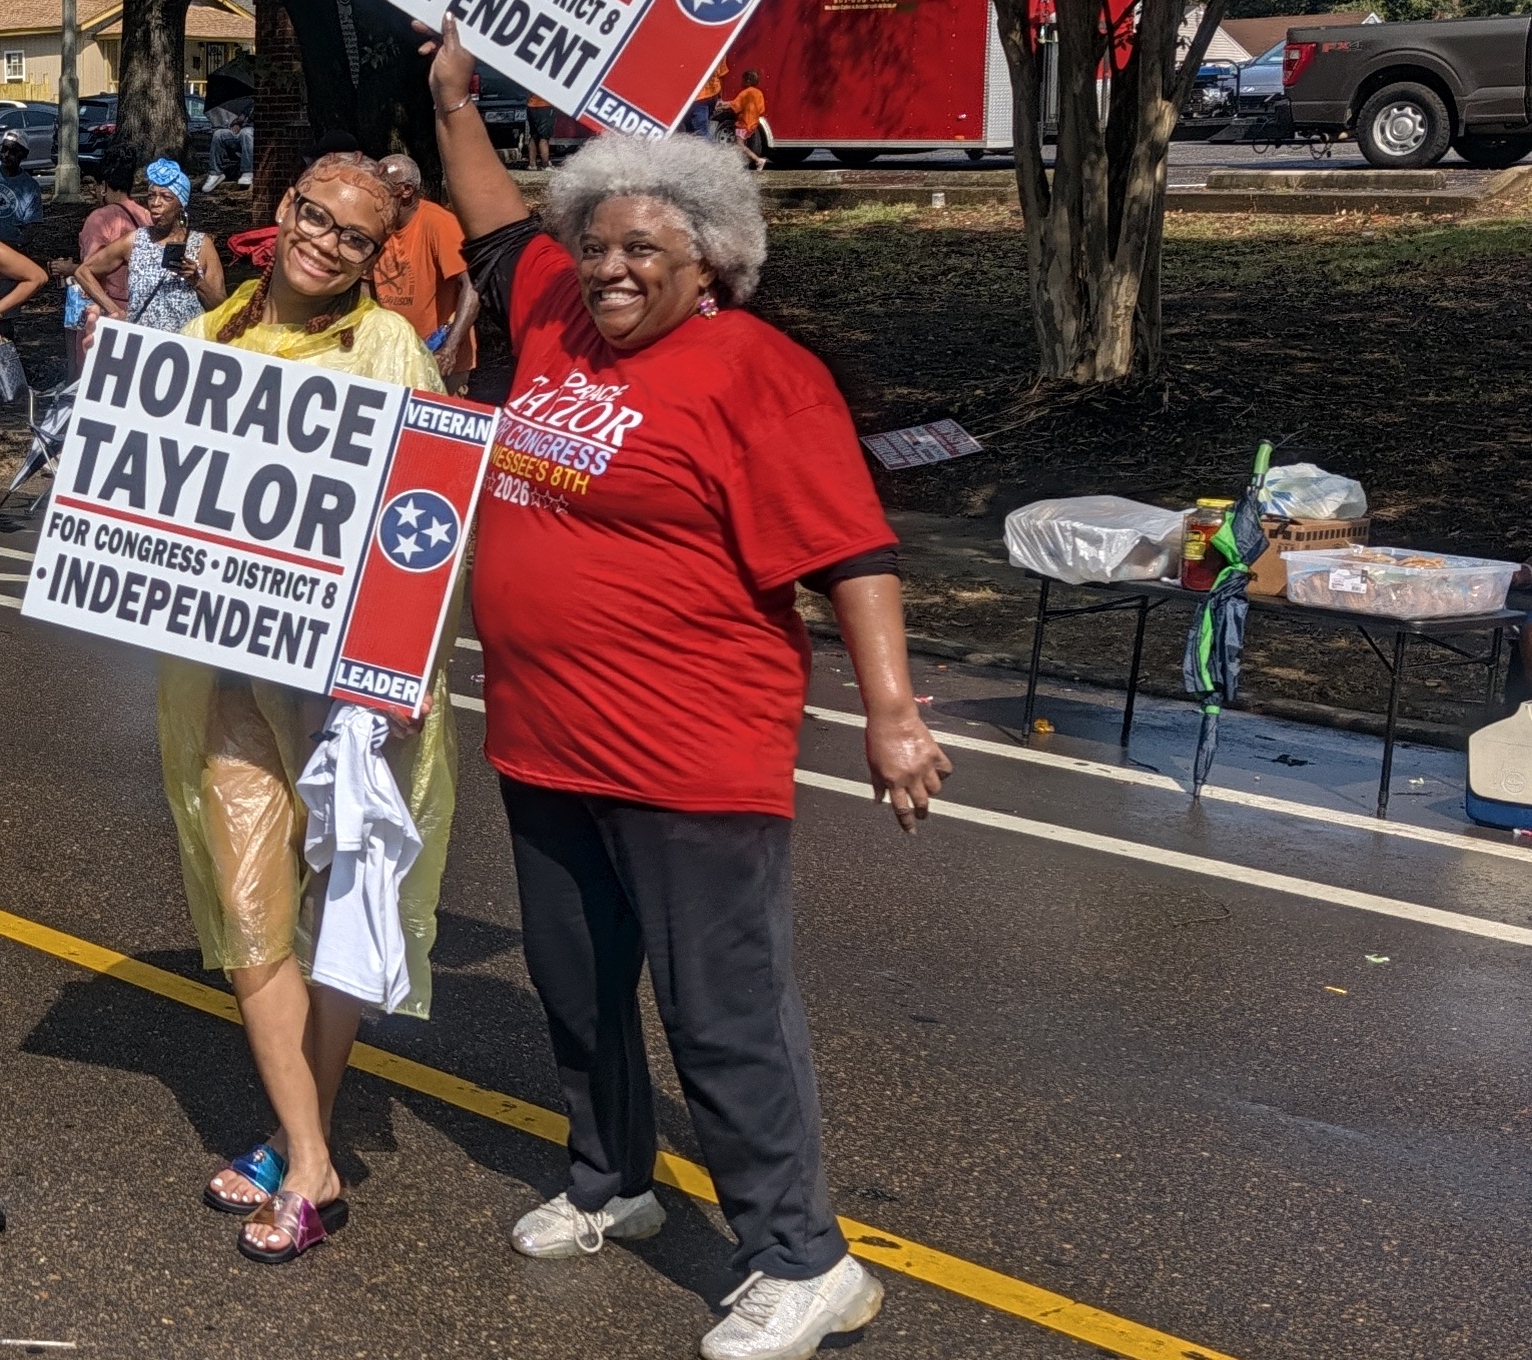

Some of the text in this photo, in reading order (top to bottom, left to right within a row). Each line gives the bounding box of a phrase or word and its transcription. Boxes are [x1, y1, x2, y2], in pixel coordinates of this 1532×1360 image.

[599, 8, 621, 36] 8
[587, 91, 664, 139] LEADER
[85, 328, 387, 467] HORACE
[404, 403, 491, 440] VETERAN
[491, 443, 590, 495] NESSEE'S 8TH
[494, 412, 611, 476] OR CONGRESS
[73, 419, 356, 559] TAYLOR
[493, 472, 530, 506] 2026
[47, 511, 338, 609] FOR CONGRESS DISTRICT 8
[48, 554, 330, 670] INDEPENDENT
[337, 661, 420, 702] LEADER
